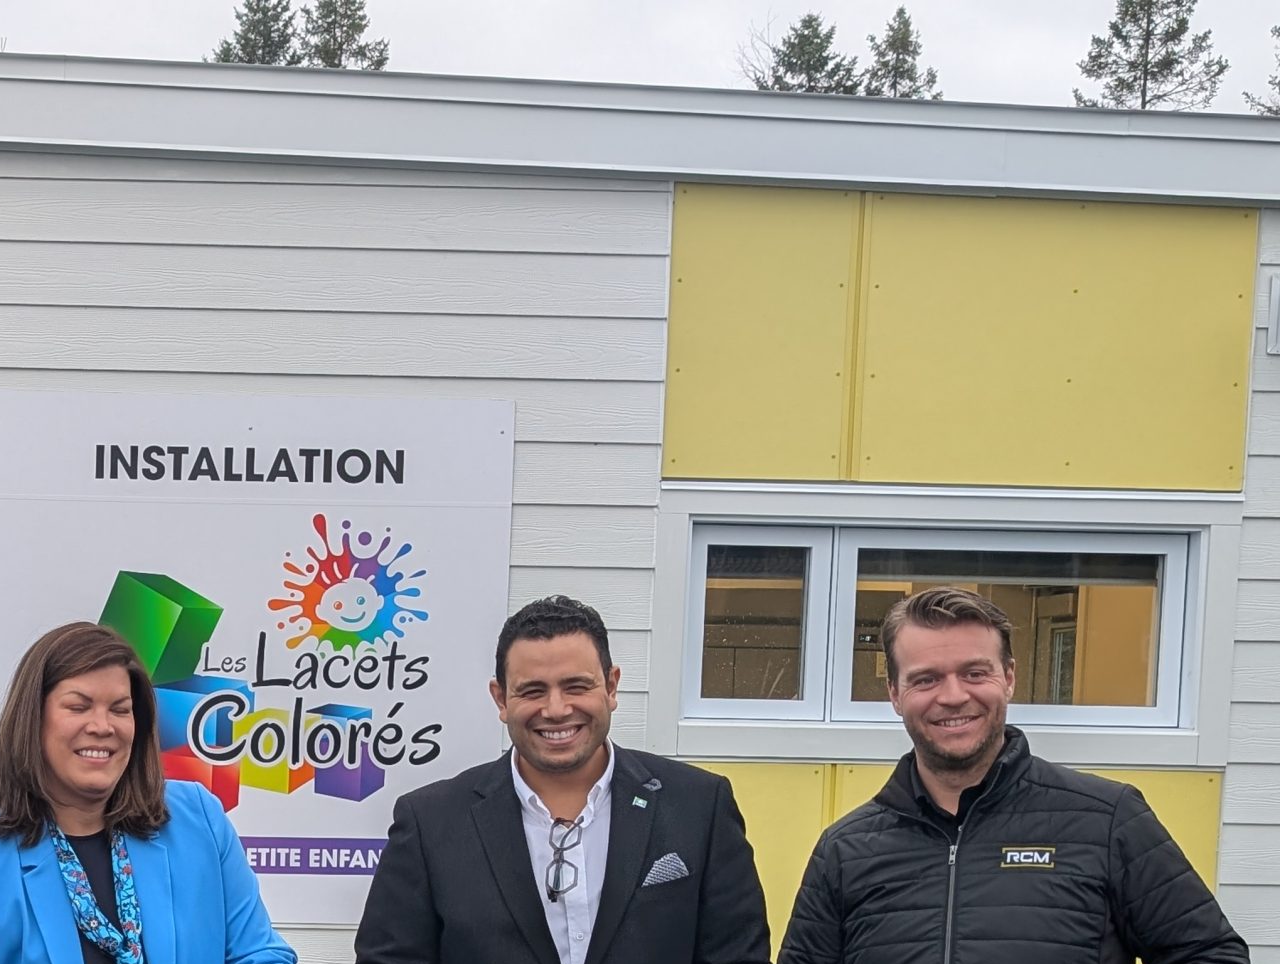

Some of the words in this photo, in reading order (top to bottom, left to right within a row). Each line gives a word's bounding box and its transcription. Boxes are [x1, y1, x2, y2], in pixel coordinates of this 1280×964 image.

[95, 444, 405, 484] INSTALLATION
[202, 646, 247, 673] Les
[252, 631, 430, 690] Lacets
[191, 697, 442, 766] Colorés
[246, 847, 301, 867] ETITE
[309, 848, 382, 868] ENFAN
[1006, 851, 1050, 864] RCM
